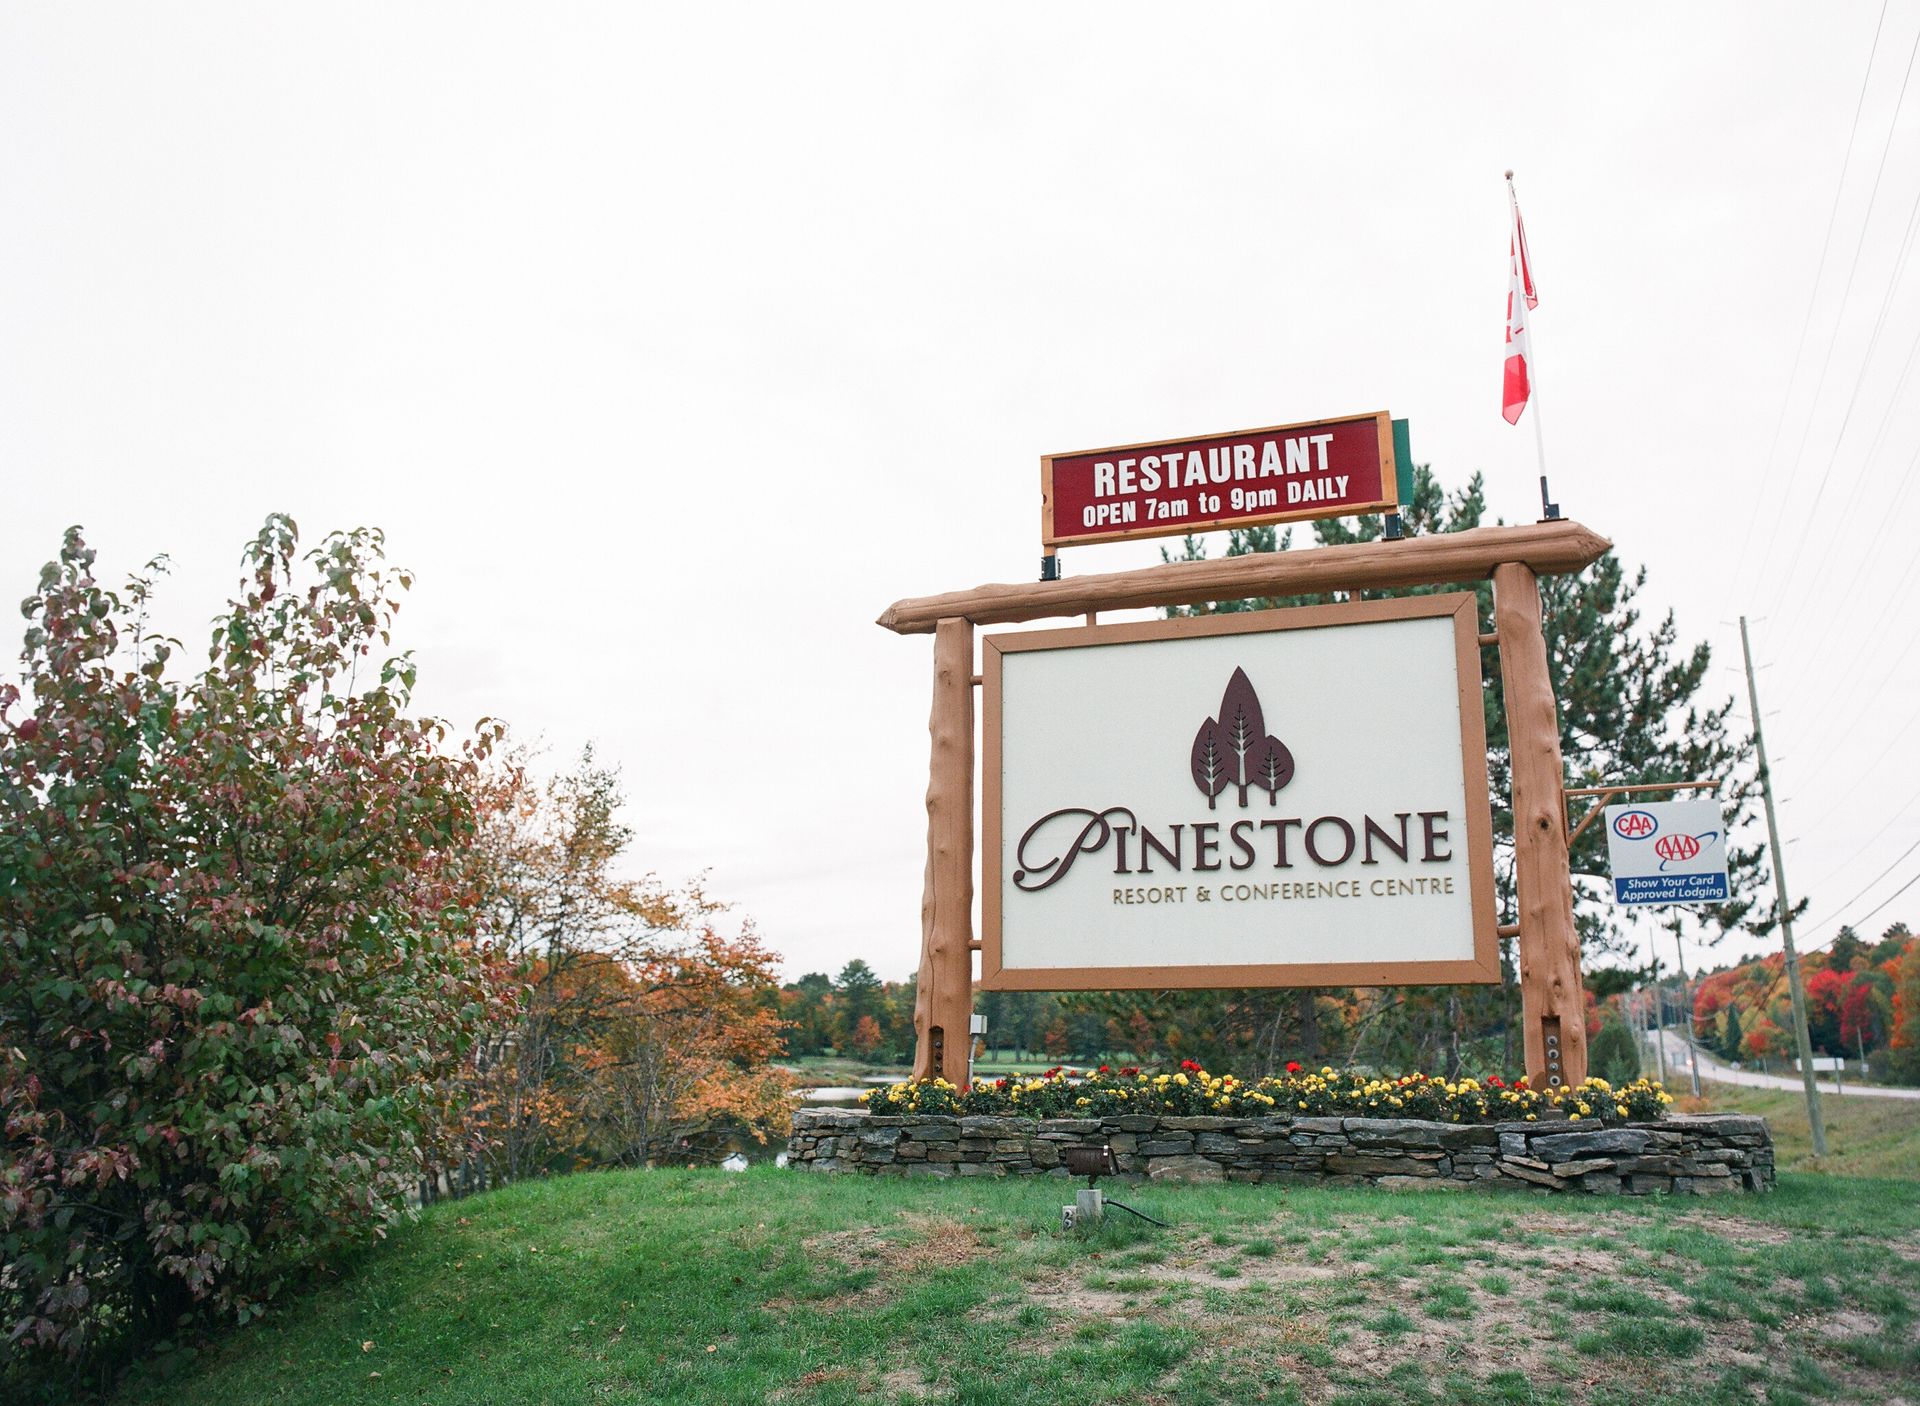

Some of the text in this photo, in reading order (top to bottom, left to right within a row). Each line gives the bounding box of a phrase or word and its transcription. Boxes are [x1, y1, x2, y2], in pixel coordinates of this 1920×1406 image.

[1094, 433, 1333, 497] RESTAURANT
[1083, 475, 1349, 527] OPEN 7am to 9pm DAILY
[1618, 814, 1652, 836] CAA
[1013, 806, 1453, 892] PINESTONE
[1660, 834, 1696, 860] AAA
[1113, 877, 1455, 905] RESORT & CONFERENCE CENTRE
[1621, 887, 1723, 902] Approved Lodging
[1628, 875, 1714, 889] Show Your Card
